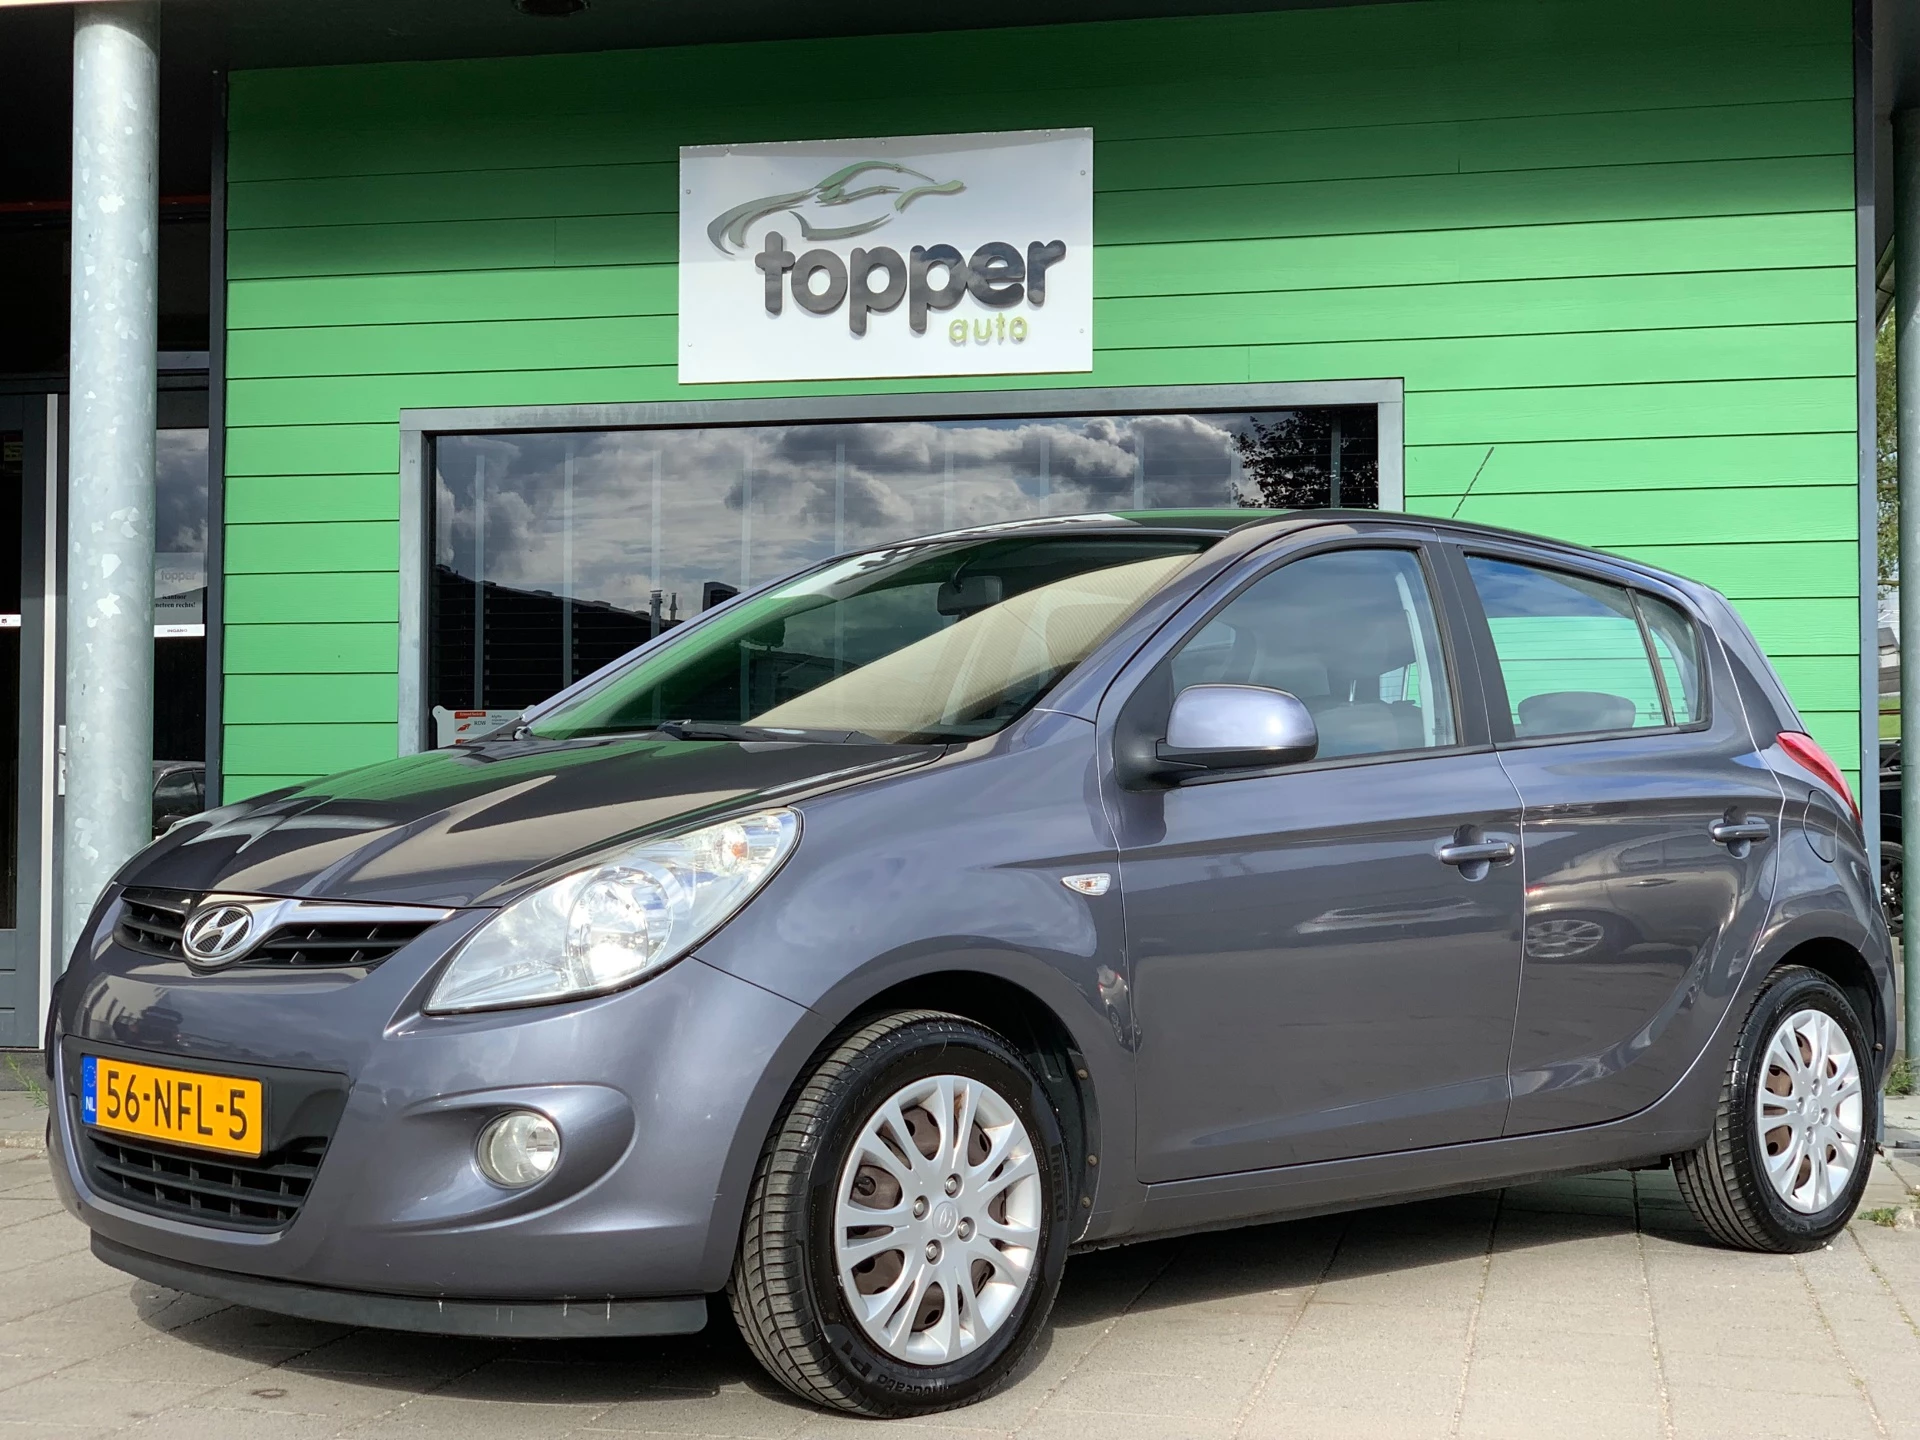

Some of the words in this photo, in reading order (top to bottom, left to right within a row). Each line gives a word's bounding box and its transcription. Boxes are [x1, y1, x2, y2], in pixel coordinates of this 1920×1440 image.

[755, 231, 1067, 336] topper
[949, 312, 1028, 344] auto
[161, 570, 196, 583] topper
[85, 1096, 96, 1112] NL
[106, 1069, 248, 1141] 56-NFL-5
